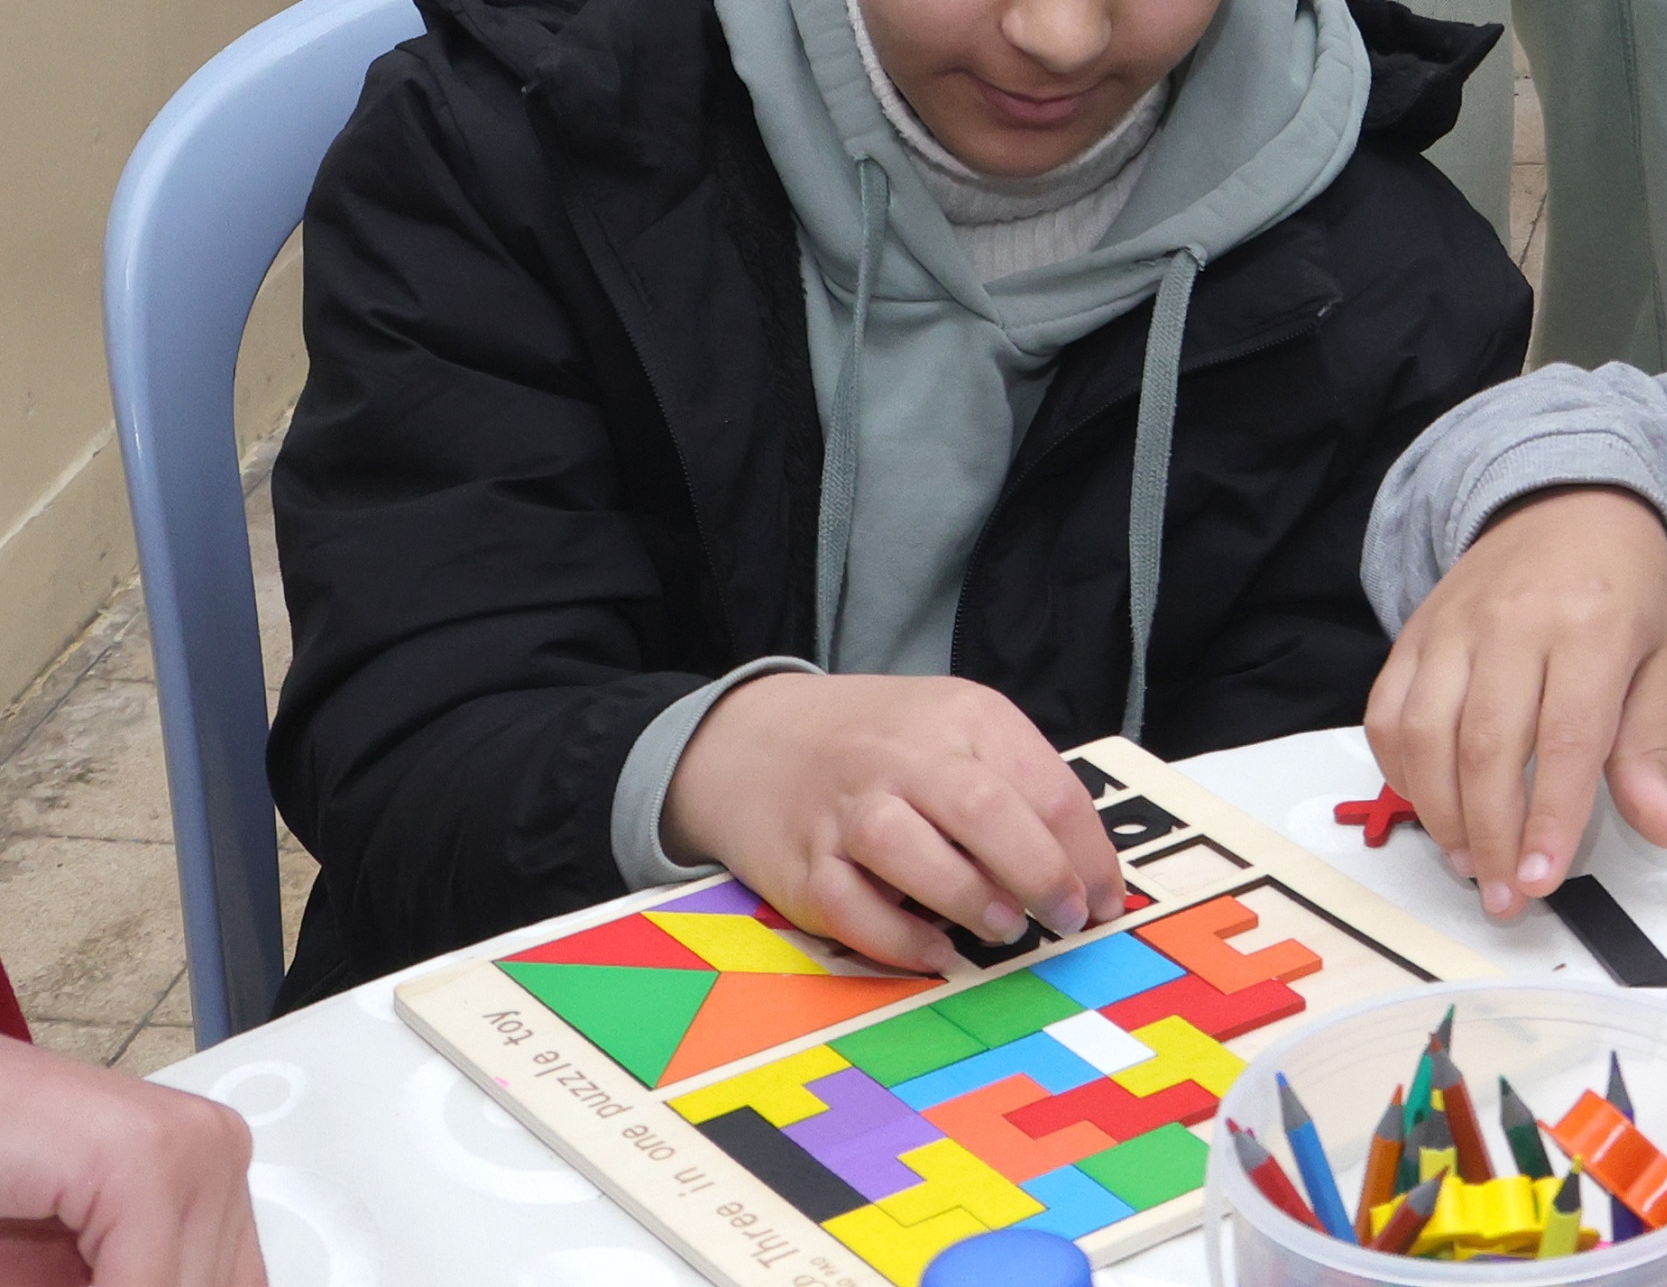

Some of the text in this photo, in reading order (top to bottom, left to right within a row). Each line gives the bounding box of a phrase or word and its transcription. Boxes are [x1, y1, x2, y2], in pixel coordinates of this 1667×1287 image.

[481, 1009, 802, 1270] Three in one puzzle toy
